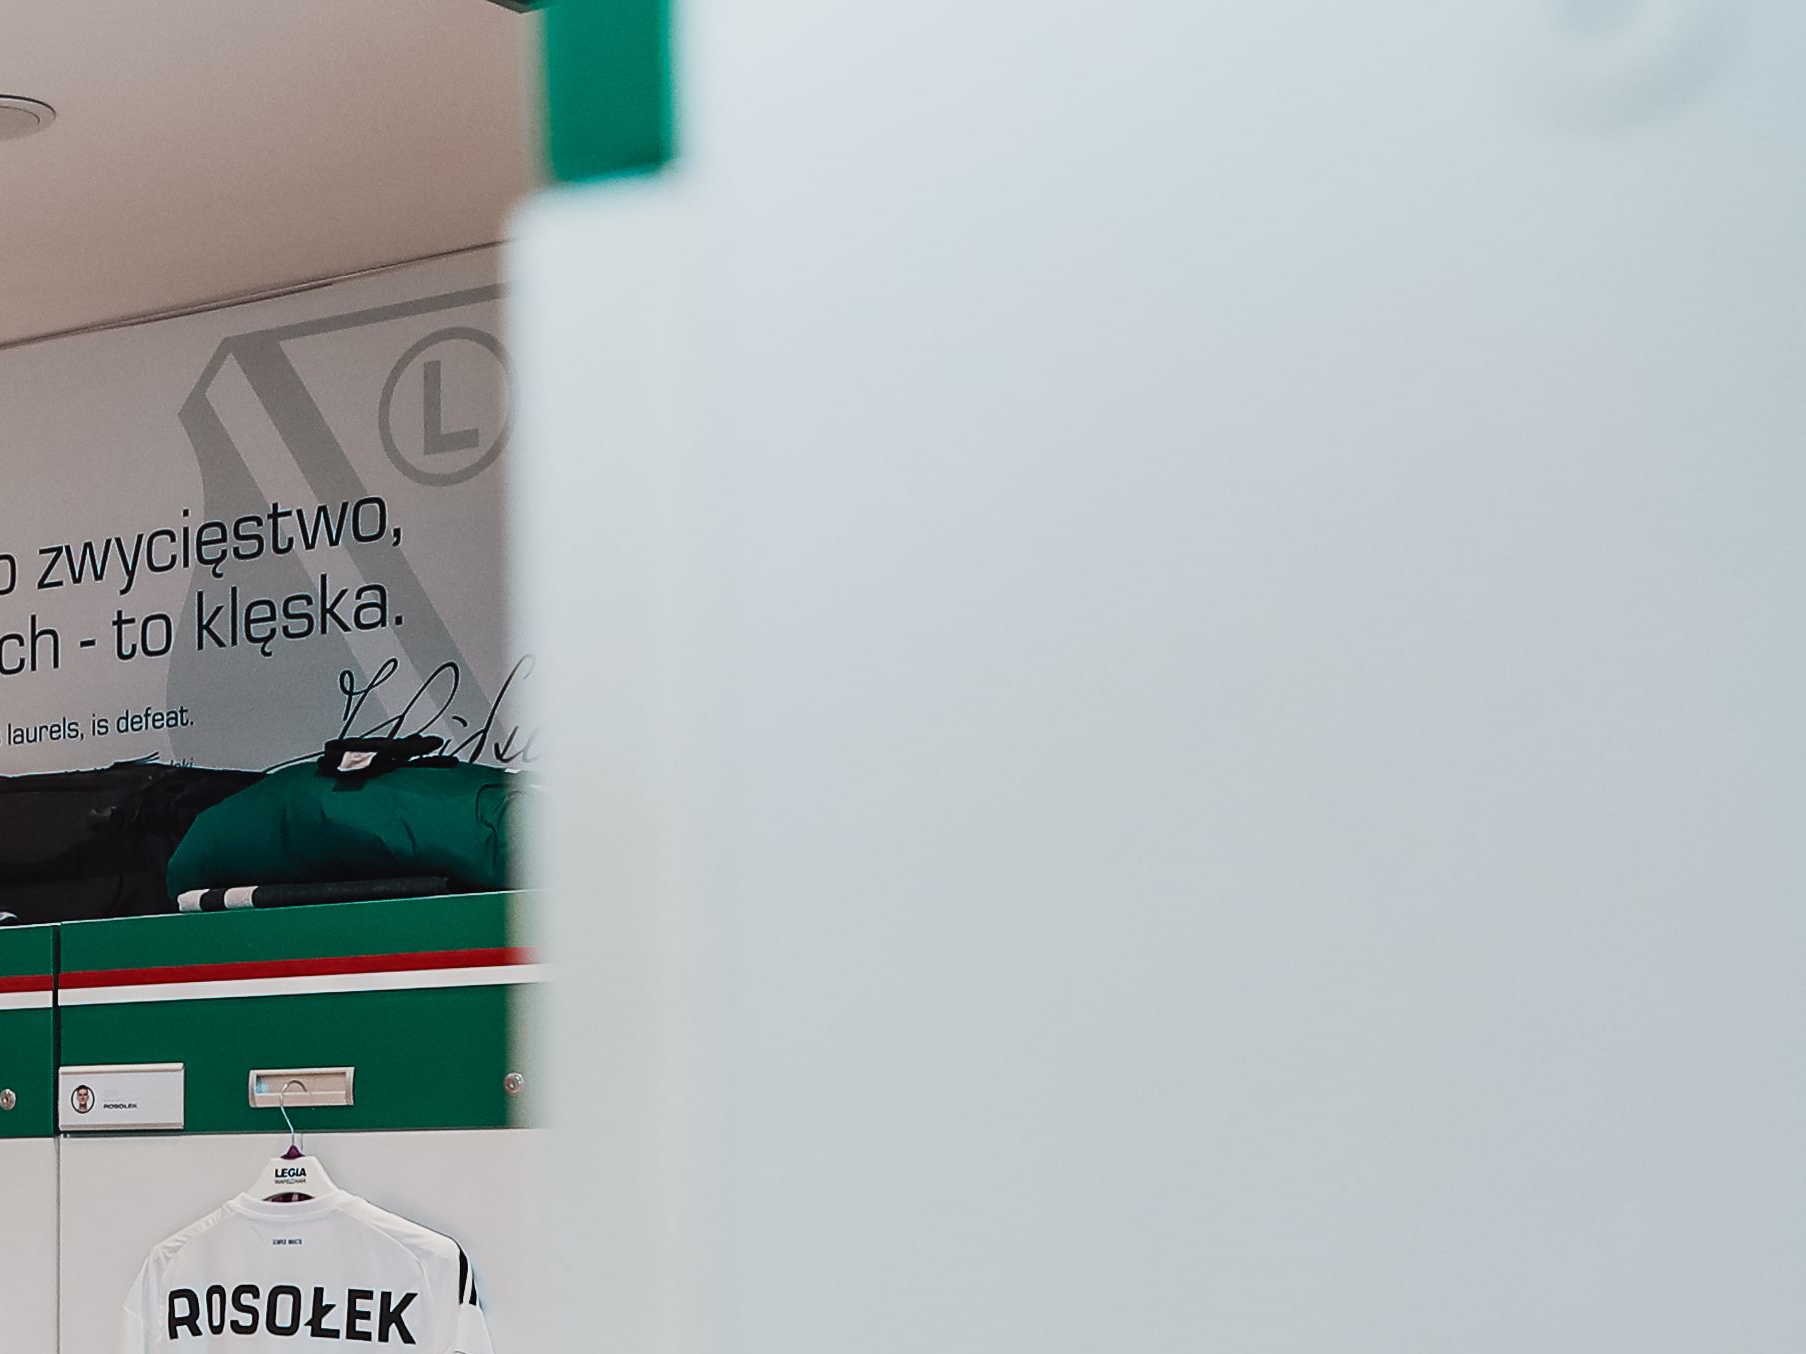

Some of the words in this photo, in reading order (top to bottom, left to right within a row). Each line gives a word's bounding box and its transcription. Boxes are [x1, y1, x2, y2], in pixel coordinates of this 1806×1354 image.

[36, 496, 402, 595] zwycięstwo,
[111, 609, 173, 661] to
[195, 573, 403, 657] klęska.
[7, 717, 84, 748] laurels,
[91, 713, 109, 736] is
[116, 705, 195, 734] defeat.
[275, 1168, 307, 1178] LEGIA
[167, 1285, 417, 1345] ROSOŁEK
